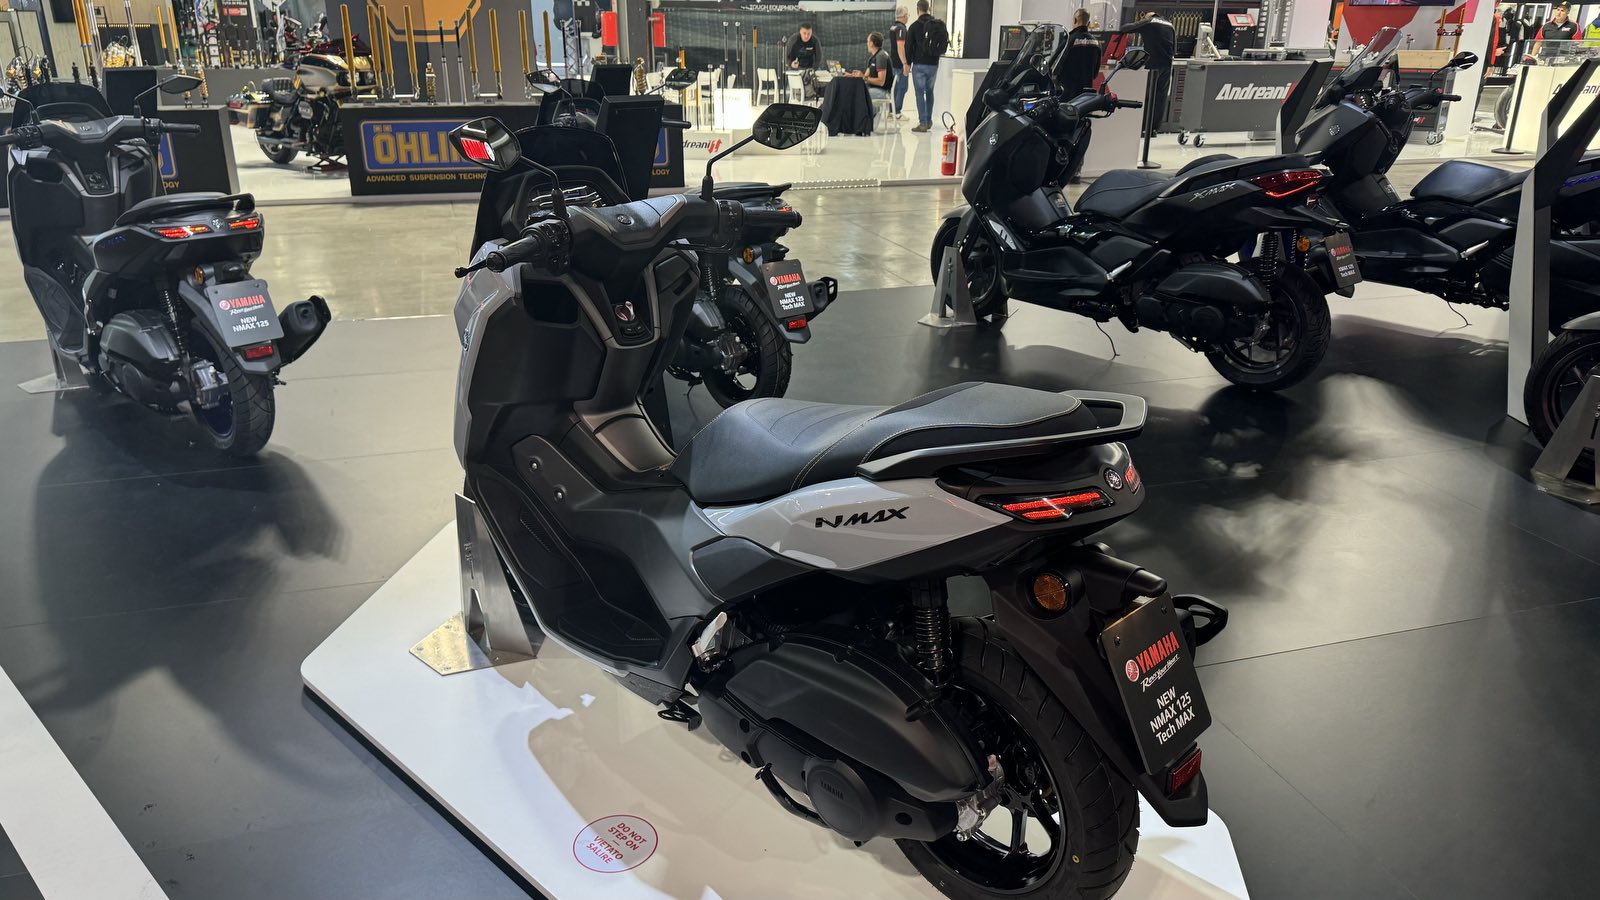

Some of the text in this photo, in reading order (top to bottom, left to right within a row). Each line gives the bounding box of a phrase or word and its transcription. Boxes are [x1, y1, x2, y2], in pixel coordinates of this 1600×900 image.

[1215, 83, 1292, 100] Andreani
[373, 124, 459, 164] ÖHLI
[366, 174, 406, 182] ADVANCED
[409, 173, 456, 181] SUSPENSION
[1189, 183, 1236, 202] XMAX
[776, 273, 801, 284] YAMAHA
[229, 294, 266, 308] YAMAHA
[780, 297, 795, 305] NMAX
[232, 319, 270, 332] NMAX 125
[240, 316, 257, 324] NEW
[815, 506, 910, 528] NMAX
[1136, 631, 1179, 673] YAMAHA
[1157, 686, 1176, 709] NEW
[1150, 691, 1192, 733] NMAX 125
[1156, 706, 1195, 745] Tech MAX
[608, 826, 640, 851] STEP ON
[617, 822, 647, 844] DO NOT
[586, 843, 613, 864] SALIRE
[593, 835, 624, 860] VIETATO
